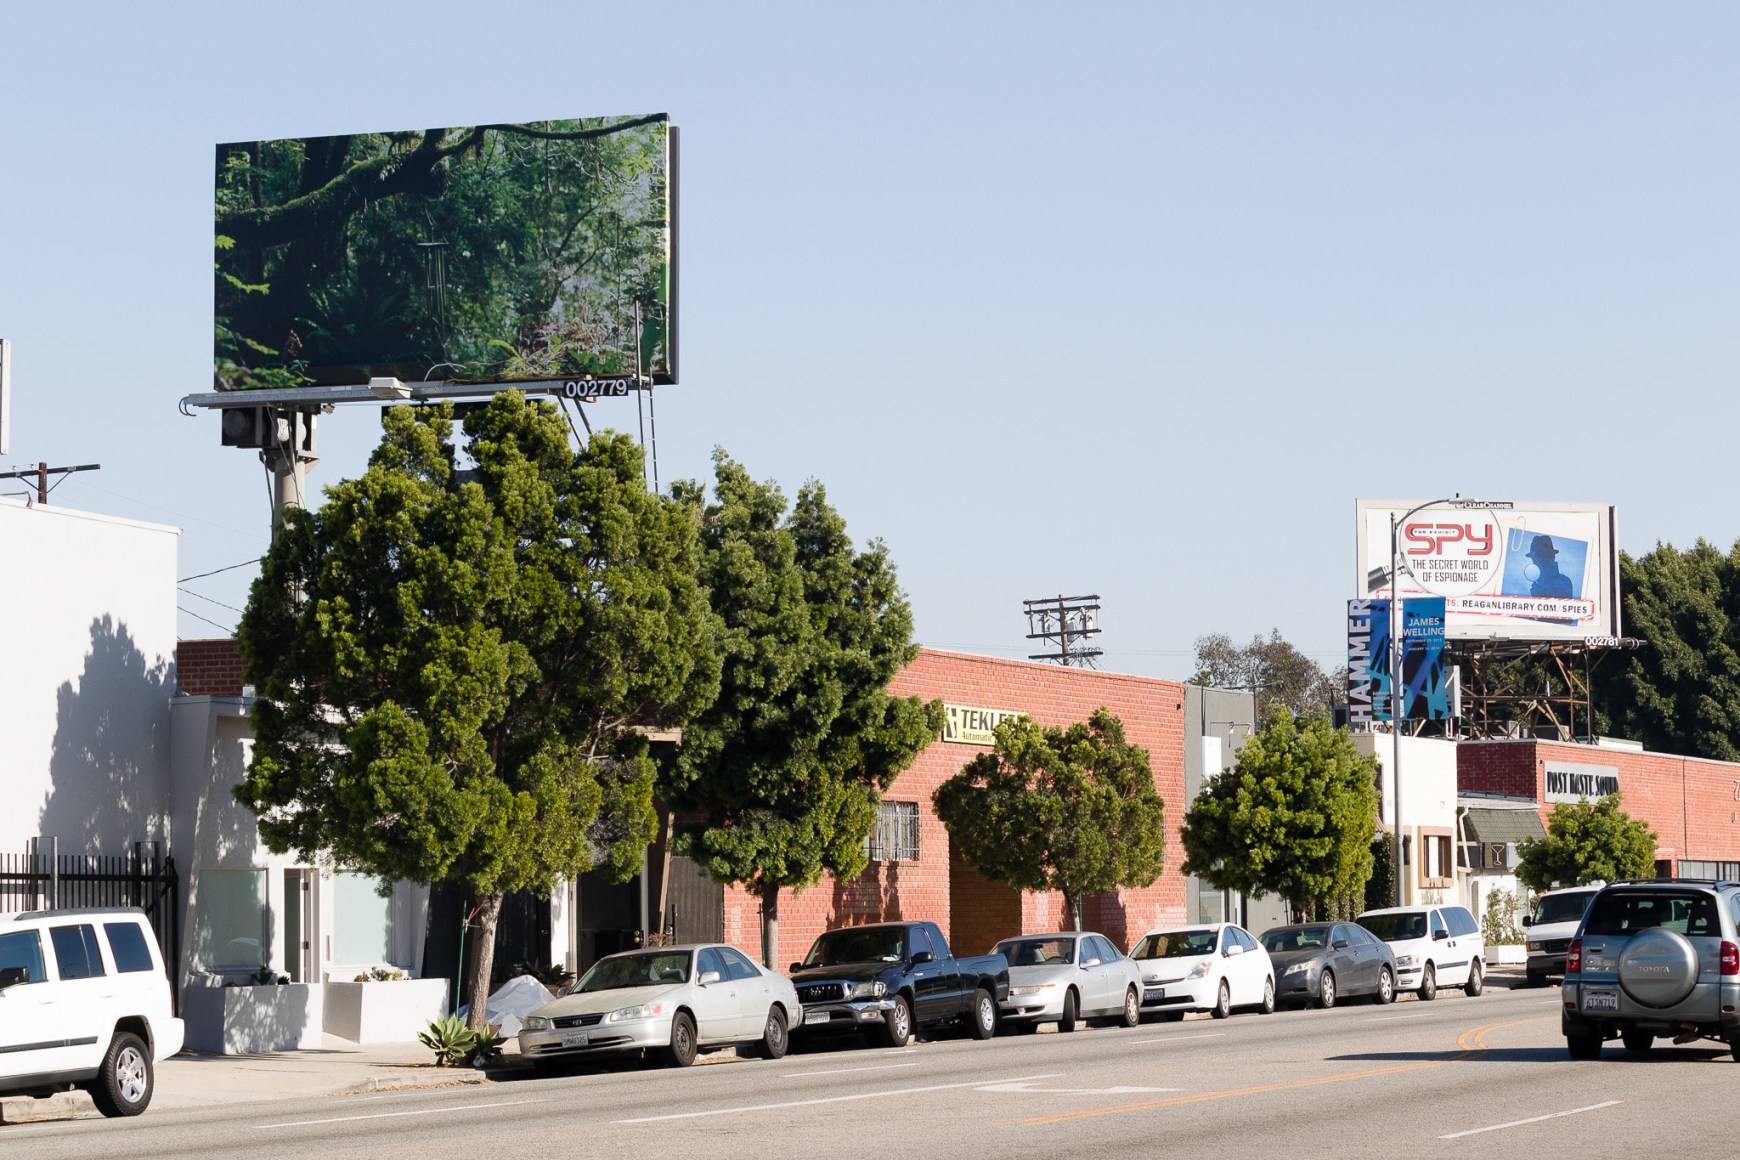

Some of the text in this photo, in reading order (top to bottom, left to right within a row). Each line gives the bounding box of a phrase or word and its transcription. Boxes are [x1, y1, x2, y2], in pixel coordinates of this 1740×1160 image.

[566, 379, 627, 397] 002779
[1404, 523, 1493, 555] SPY
[1412, 559, 1489, 570] THE SECRET WORLD
[1422, 572, 1479, 582] OF ESPIONAGE
[1408, 617, 1440, 627] JAMES
[1403, 627, 1445, 636] WELLING
[1585, 636, 1619, 647] 002781
[1348, 599, 1373, 722] HAMMER
[1547, 771, 1619, 797] POST HASTE SOUND
